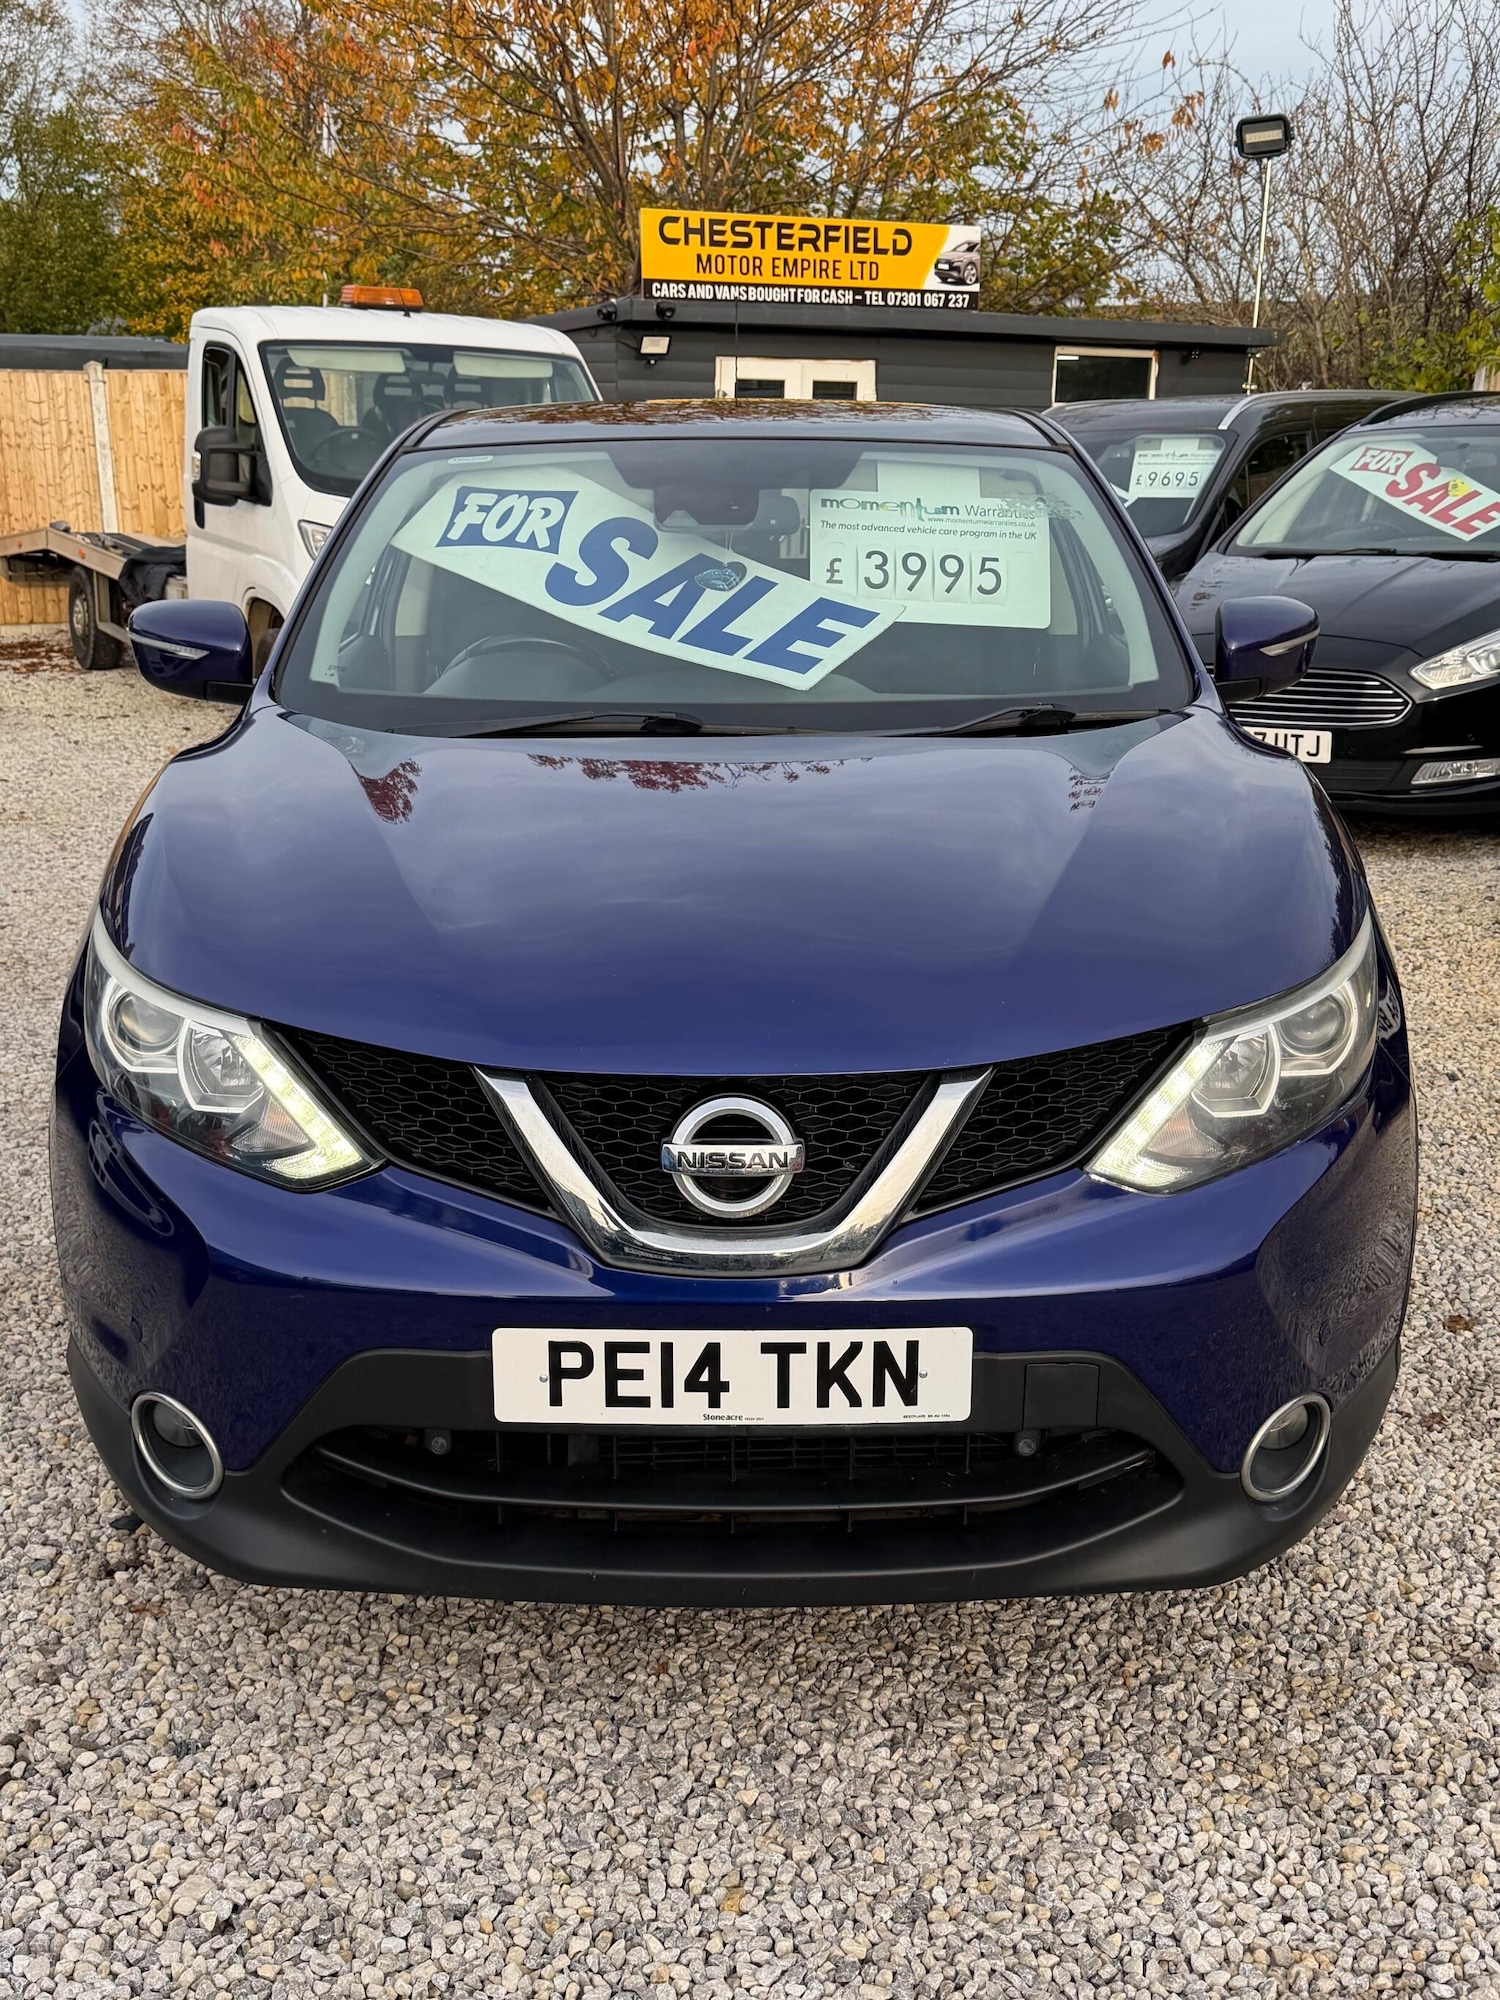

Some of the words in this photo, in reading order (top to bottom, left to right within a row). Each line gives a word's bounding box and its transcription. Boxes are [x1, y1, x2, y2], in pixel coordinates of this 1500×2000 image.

[658, 216, 913, 256] CHESTERFIELD
[696, 253, 763, 277] MOTOR
[771, 257, 842, 280] EMPIRE
[850, 260, 880, 281] LTD
[651, 282, 686, 299] CARS
[687, 283, 714, 300] AND
[714, 284, 747, 301] VANS
[750, 286, 796, 303] BOUGHT
[797, 288, 821, 304] FOR
[821, 289, 854, 305] CASH
[864, 290, 886, 306] TEL
[887, 291, 922, 307] 07301
[924, 292, 946, 308] 067
[948, 293, 970, 309] 237
[1354, 449, 1407, 474] FOR
[820, 498, 960, 521] momentum
[1385, 462, 1500, 535] SALE
[446, 491, 566, 549] FOR
[820, 519, 837, 530] The
[838, 522, 860, 531] most
[861, 523, 906, 533] advanced
[907, 525, 937, 535] vehicle
[938, 528, 958, 536] care
[959, 529, 997, 539] program
[999, 530, 1008, 538] in
[1009, 530, 1023, 540] the
[1024, 531, 1037, 540] UK
[545, 516, 882, 675] SALE
[677, 1151, 788, 1169] NISSAN
[548, 1340, 730, 1409] PE14
[760, 1340, 920, 1409] TKN
[702, 1413, 744, 1421] Stoneacre
